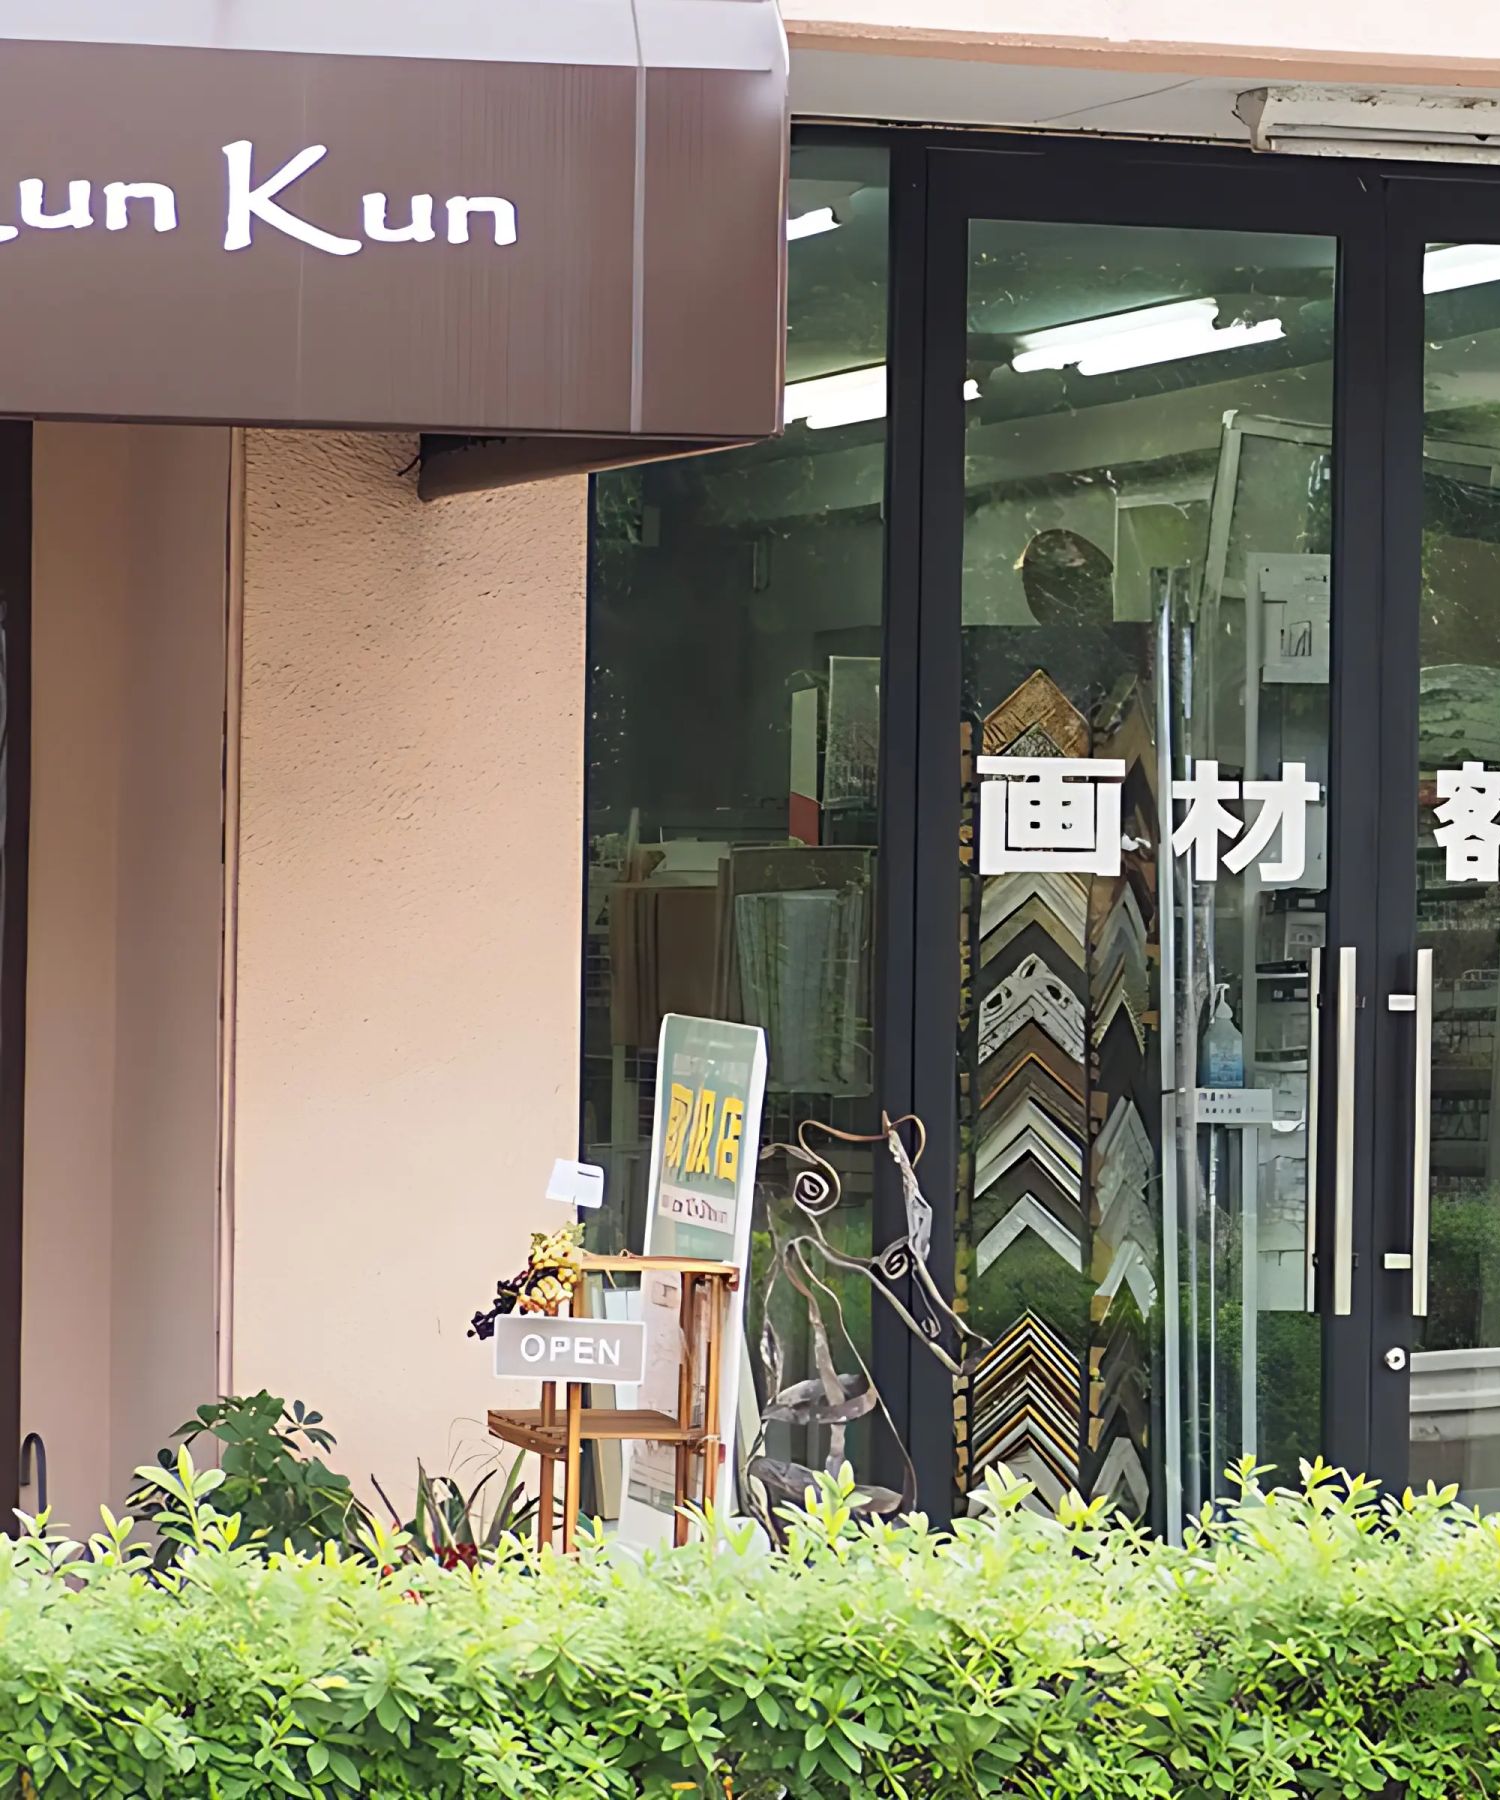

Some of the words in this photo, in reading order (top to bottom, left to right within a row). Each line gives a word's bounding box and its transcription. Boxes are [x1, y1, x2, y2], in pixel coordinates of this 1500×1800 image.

[0, 178, 177, 242] un
[222, 140, 517, 256] Kun
[976, 755, 1320, 882] 画材
[520, 1333, 621, 1367] OPEN
